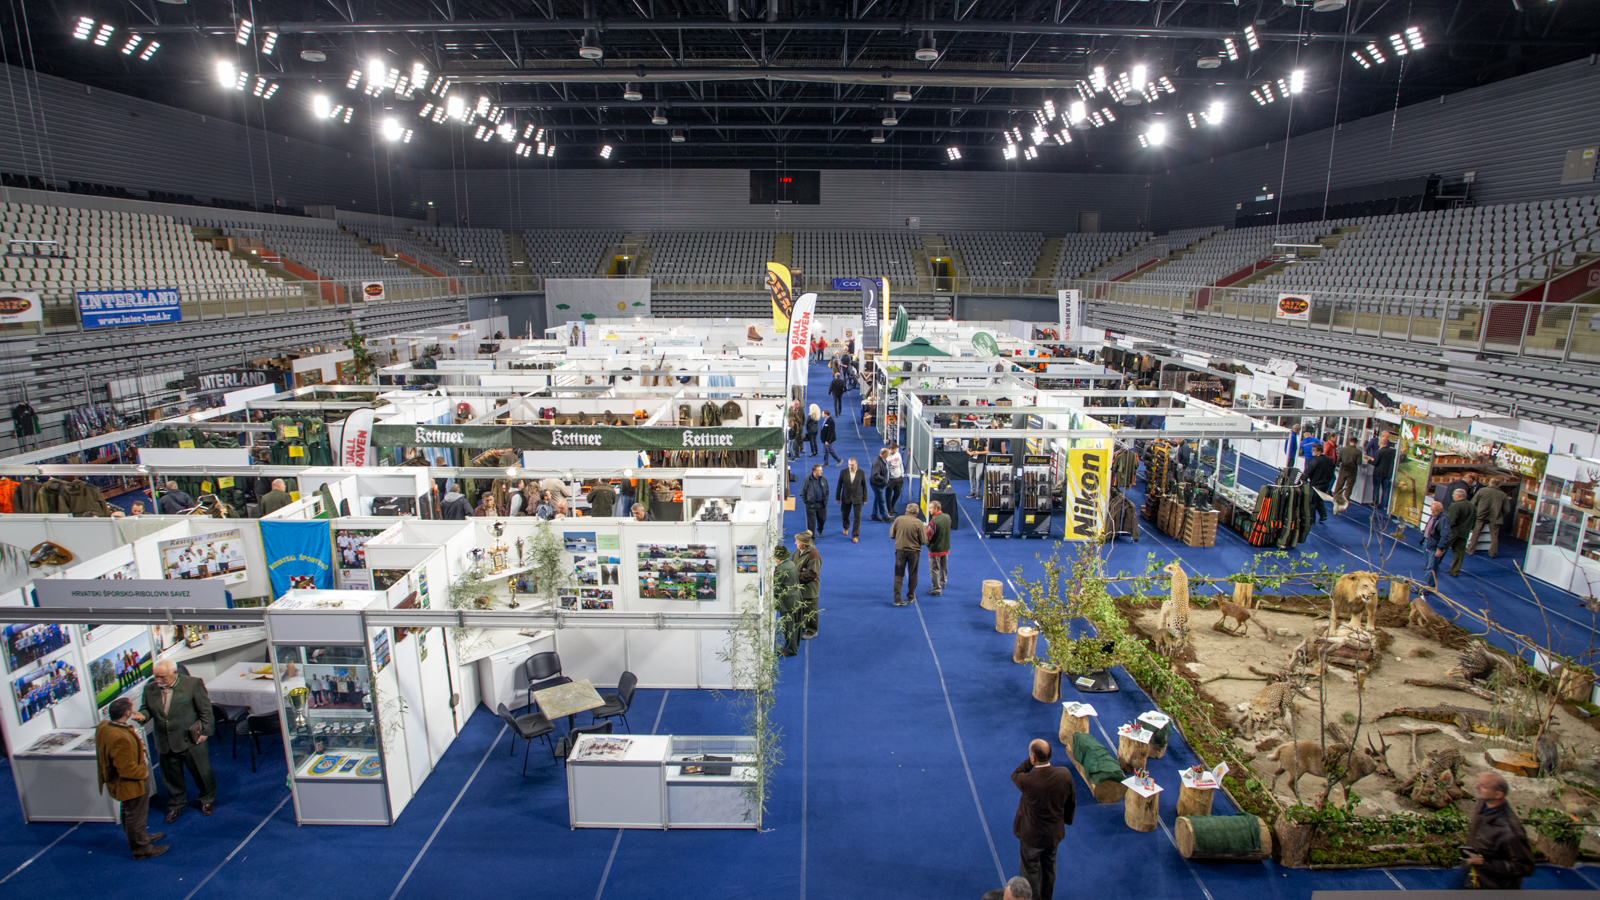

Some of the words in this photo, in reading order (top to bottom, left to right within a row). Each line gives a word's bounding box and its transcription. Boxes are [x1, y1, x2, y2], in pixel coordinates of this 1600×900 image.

[0, 300, 29, 310] RIZO
[79, 291, 178, 309] INTERLAND
[98, 313, 171, 326] www.inter-land.hr
[198, 371, 266, 390] INTERLAND
[414, 426, 464, 444] Kettner
[551, 429, 602, 446] Kettner
[682, 429, 733, 447] Kettner
[1435, 433, 1491, 455] AMMUNITION
[1491, 447, 1537, 467] FACTORY
[1074, 453, 1100, 537] Nikon
